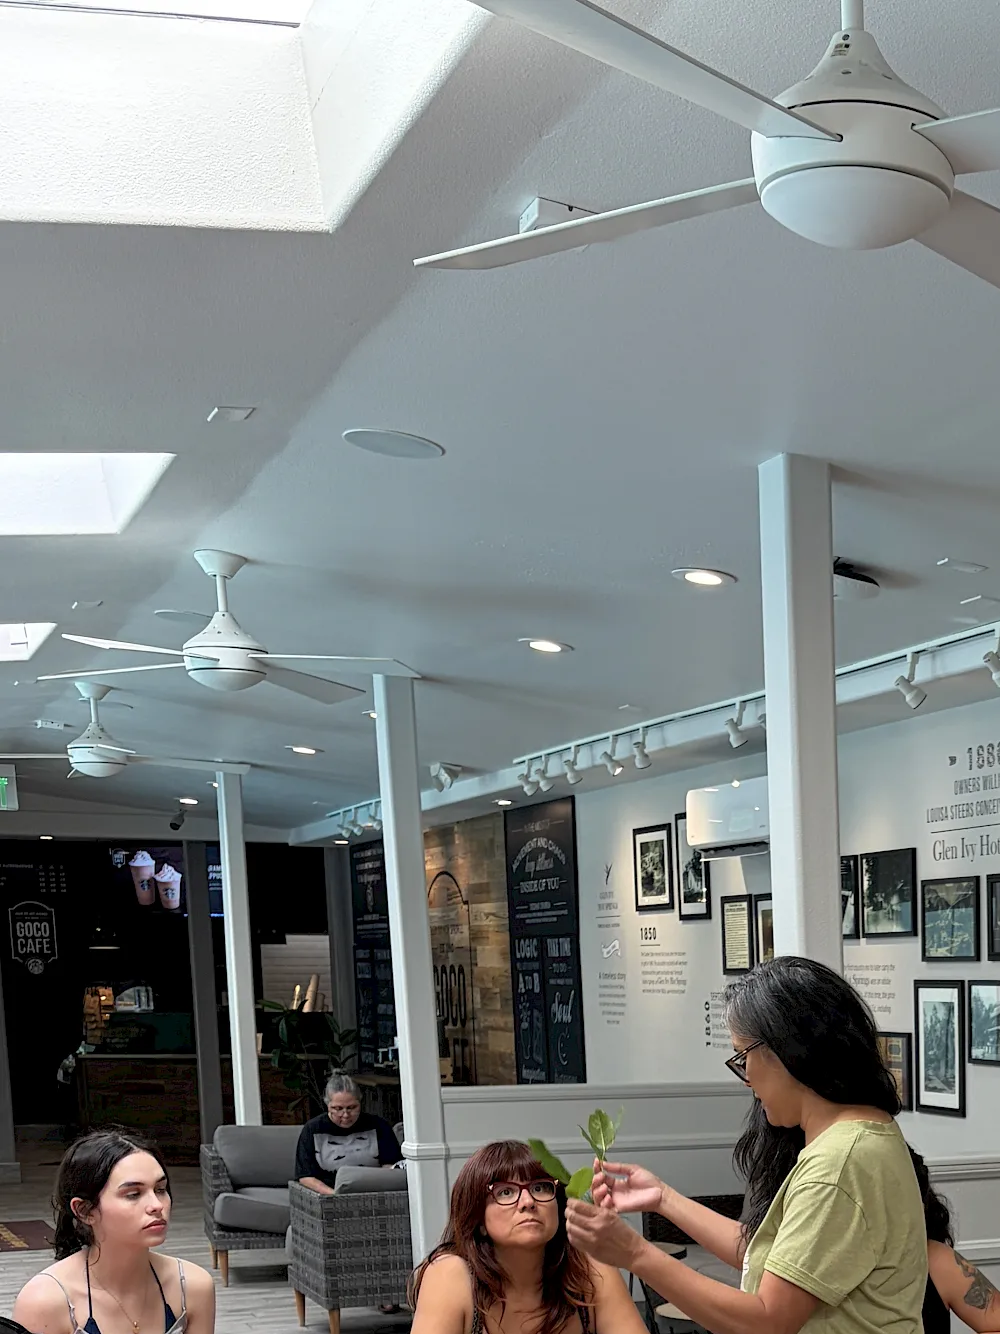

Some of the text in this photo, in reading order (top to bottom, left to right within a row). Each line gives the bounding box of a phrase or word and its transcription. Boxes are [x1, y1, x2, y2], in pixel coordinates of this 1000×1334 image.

[954, 777, 980, 795] OWNERS
[926, 806, 948, 823] LOUISA
[950, 802, 974, 820] STEERS
[933, 840, 958, 861] Glen
[961, 838, 976, 862] Ivy
[980, 835, 1000, 856] Hot
[16, 921, 50, 938] GOCO
[640, 927, 657, 940] 1850
[17, 938, 51, 954] CAFE
[515, 938, 538, 959] LOGIC
[518, 972, 525, 993] A
[533, 972, 540, 993] B
